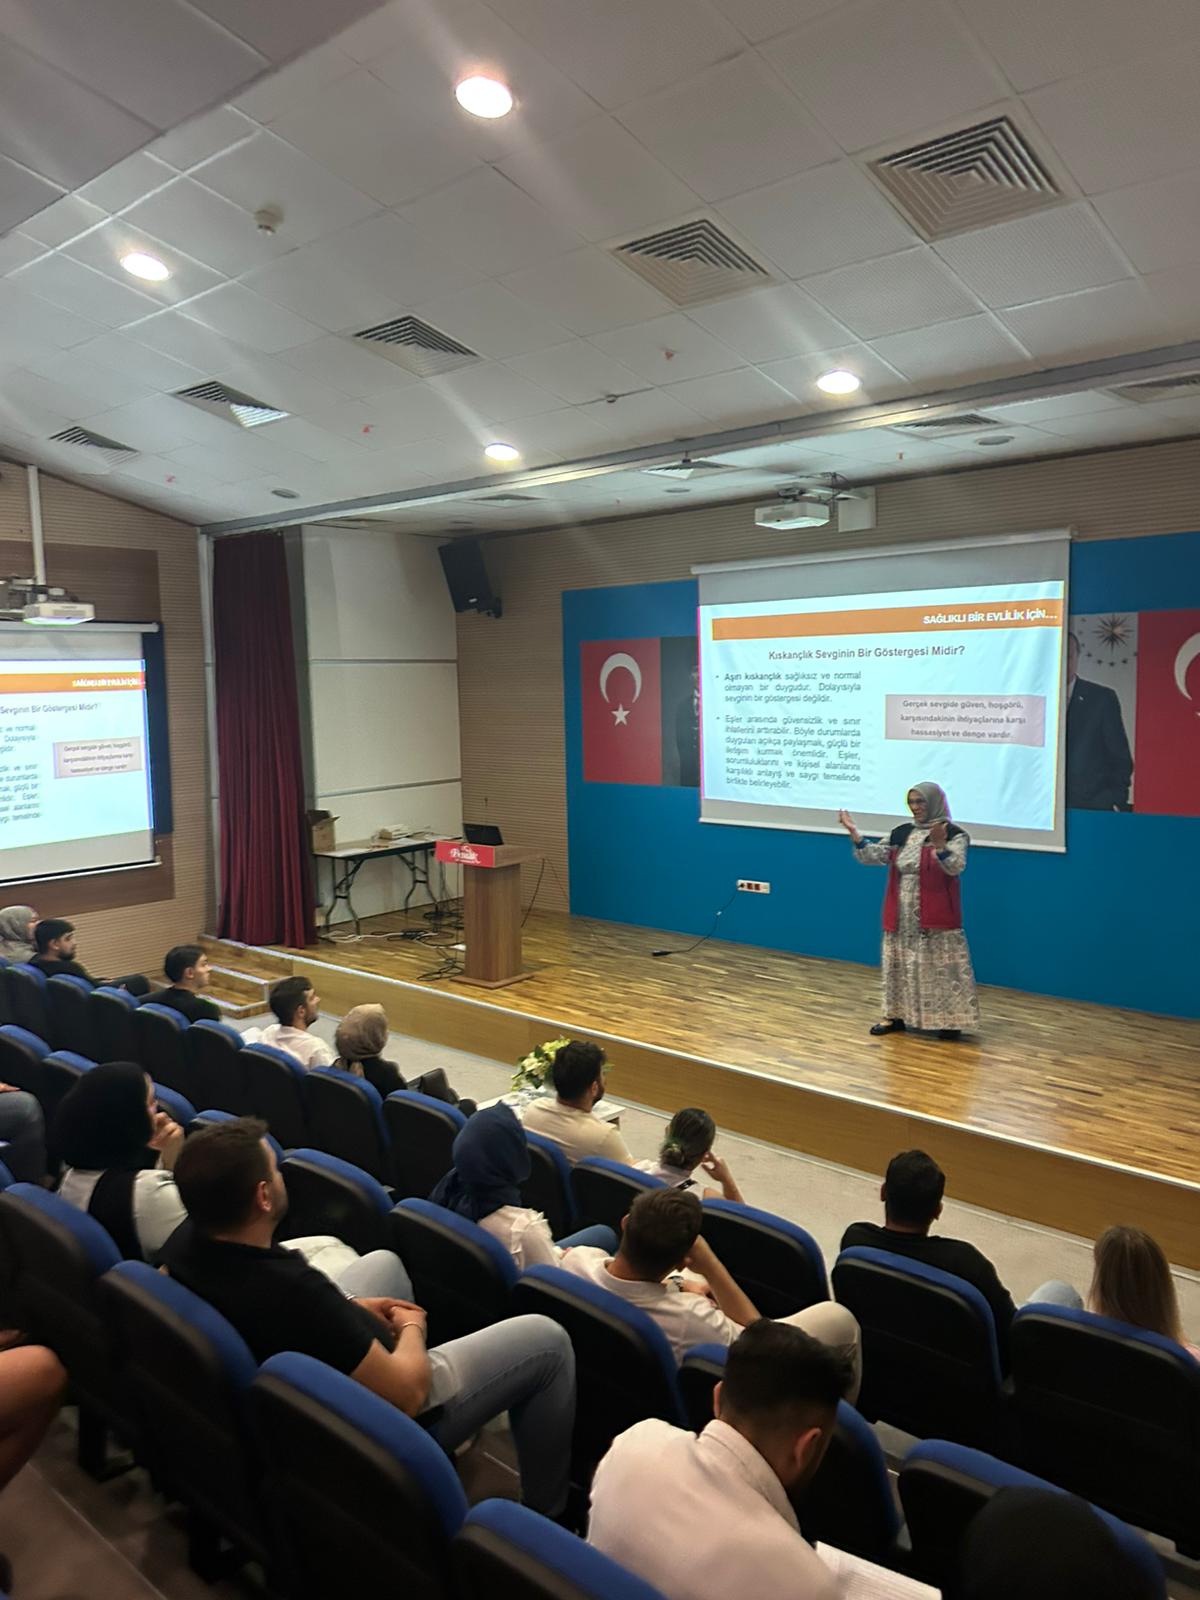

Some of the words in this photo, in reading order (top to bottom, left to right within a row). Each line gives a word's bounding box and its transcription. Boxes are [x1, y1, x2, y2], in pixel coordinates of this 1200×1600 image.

[922, 613, 966, 624] SAĞLIKLI
[968, 611, 985, 622] BİR
[986, 609, 1025, 621] EVLİLİK
[768, 650, 813, 661] Kıskançlık
[814, 648, 855, 660] Sevginin
[857, 648, 873, 657] Bir
[874, 646, 929, 658] Göstergesi
[931, 645, 966, 655] Midir?
[833, 671, 861, 679] normal
[759, 683, 769, 691] bir
[818, 682, 861, 692] Dolayısıyla
[754, 694, 763, 702] bir
[902, 700, 928, 709] Gerçek
[929, 701, 959, 710] sevgide
[960, 701, 987, 710] güven,
[793, 727, 815, 737] Böyle
[850, 740, 861, 749] bir
